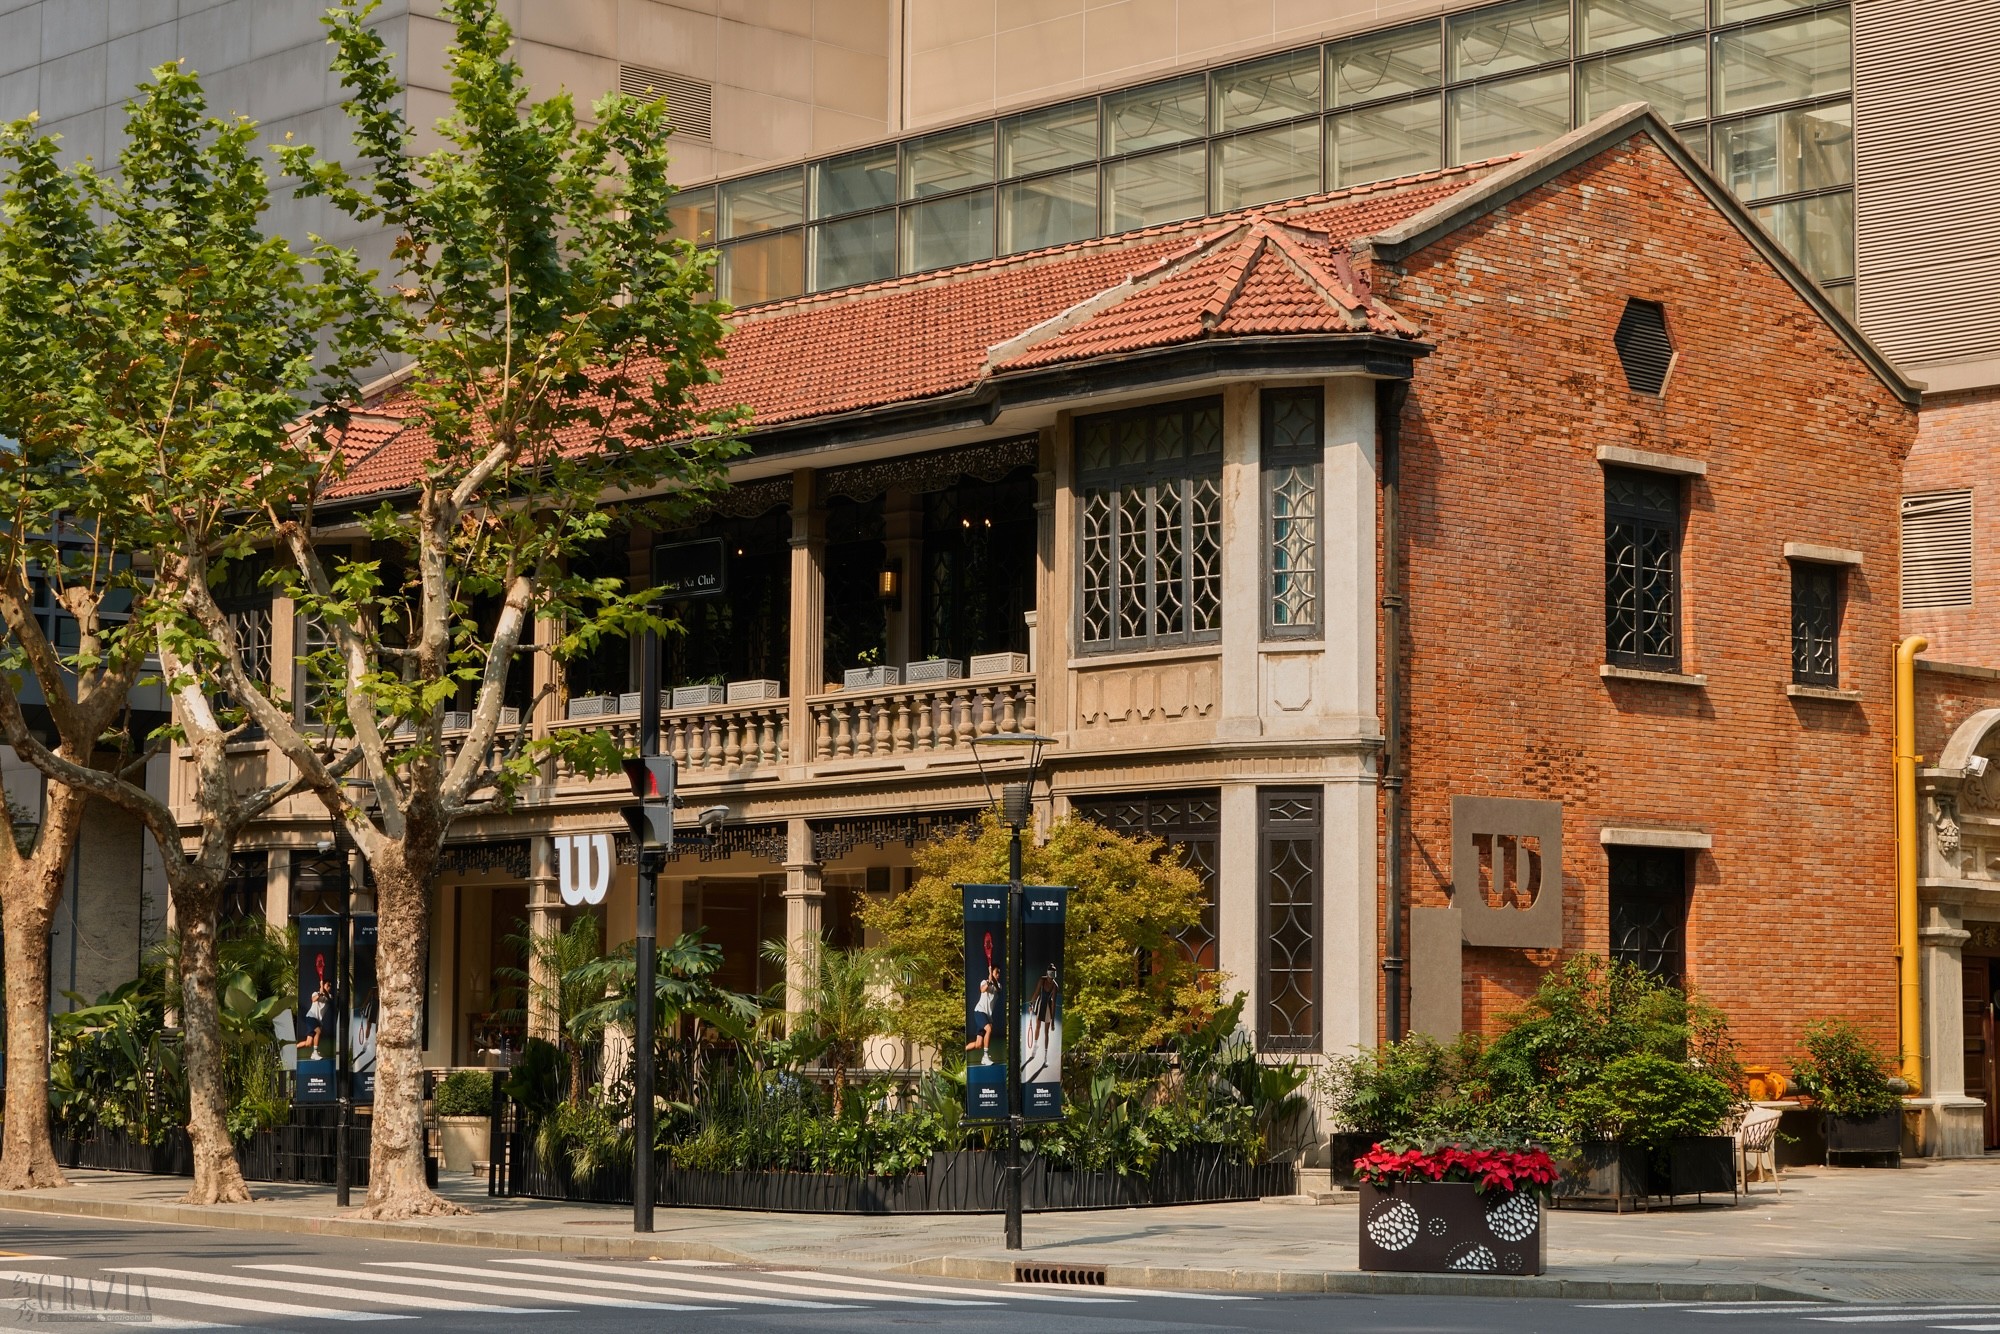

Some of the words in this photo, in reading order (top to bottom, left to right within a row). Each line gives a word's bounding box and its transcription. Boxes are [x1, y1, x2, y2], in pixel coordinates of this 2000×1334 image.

[697, 574, 716, 586] Club
[555, 835, 609, 906] W
[1472, 833, 1542, 912] W
